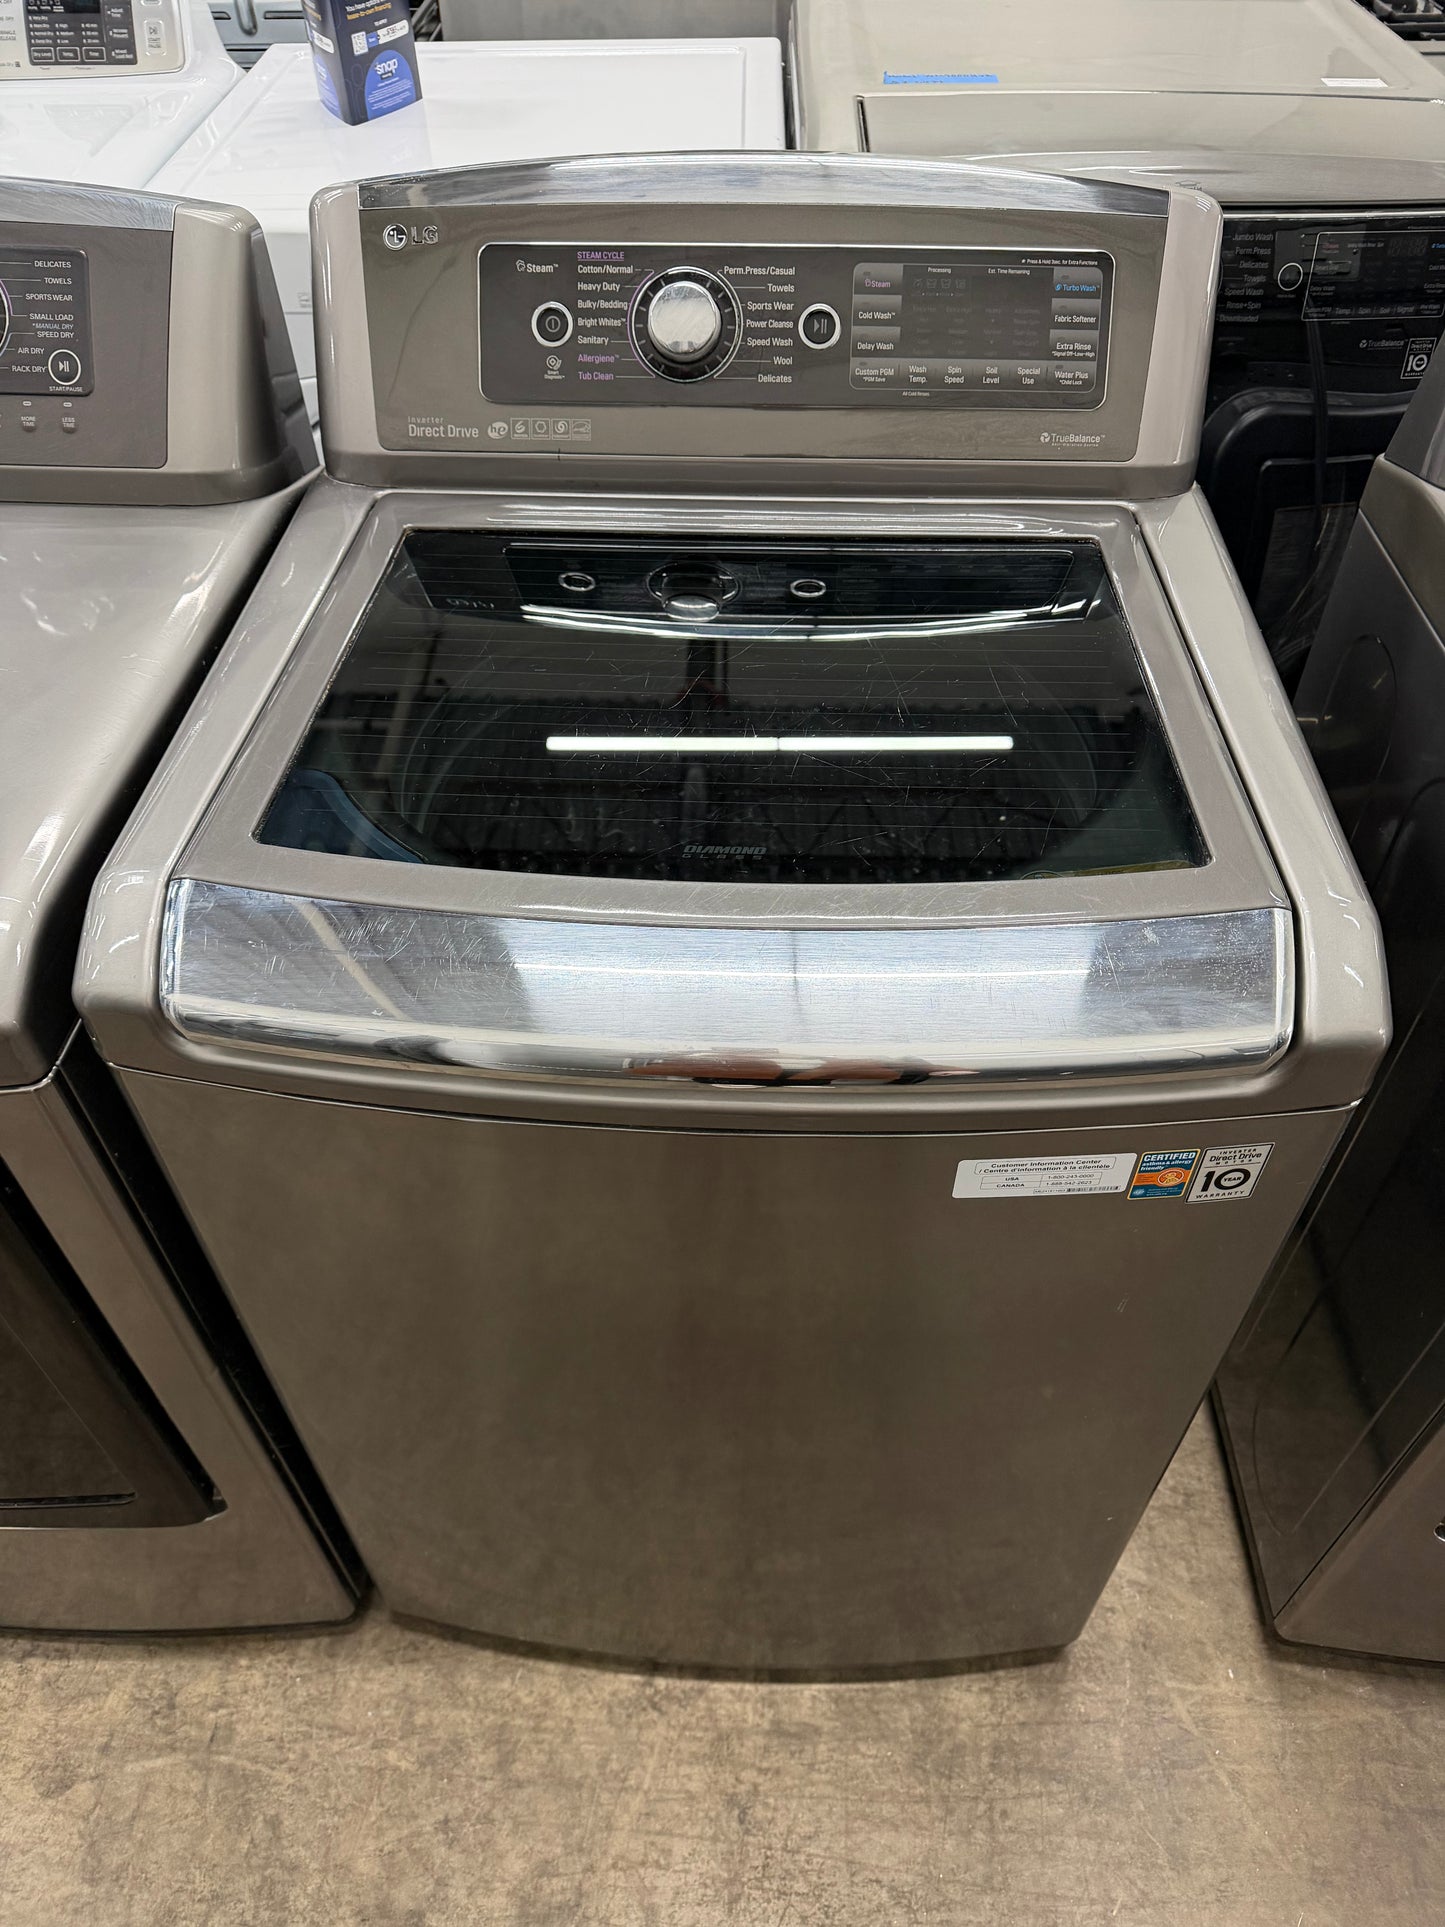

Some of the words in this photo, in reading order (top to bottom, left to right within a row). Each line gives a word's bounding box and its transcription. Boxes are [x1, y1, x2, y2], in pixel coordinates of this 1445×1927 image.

[376, 58, 398, 74] snap
[411, 225, 439, 245] LG
[577, 251, 601, 260] STEAM
[602, 251, 624, 260] CYCLE
[577, 264, 633, 274] Cotton/Normal
[1239, 260, 1269, 268] Delicates
[724, 266, 795, 277] Perm.Press/Casual
[577, 282, 600, 293] Heavy
[602, 282, 620, 293] Duty
[768, 283, 795, 293] Towels
[1224, 288, 1244, 296] Speed
[577, 300, 628, 311] Bulky/Bedding
[747, 301, 771, 312] Sports
[772, 302, 794, 311] Wear
[1358, 307, 1371, 315] Spin
[577, 317, 597, 328] Bright
[746, 319, 767, 329] Power
[768, 320, 794, 329] Cleanse
[577, 335, 609, 346] Sanitary
[747, 337, 769, 347] Speed
[771, 337, 793, 347] Wash
[857, 342, 874, 351] Delay
[773, 356, 793, 365] Wool
[1407, 354, 1428, 372] 10
[947, 366, 962, 374] Spin
[1017, 367, 1040, 375] Special
[578, 371, 591, 380] Tub
[593, 371, 614, 381] Clean
[758, 374, 792, 383] Delicates
[944, 376, 964, 384] Speed
[408, 424, 445, 437] Direct
[448, 424, 479, 437] Drive
[683, 845, 768, 855] DIAMOND
[1144, 1152, 1196, 1161] CERTIFIED
[1201, 1168, 1251, 1192] 10
